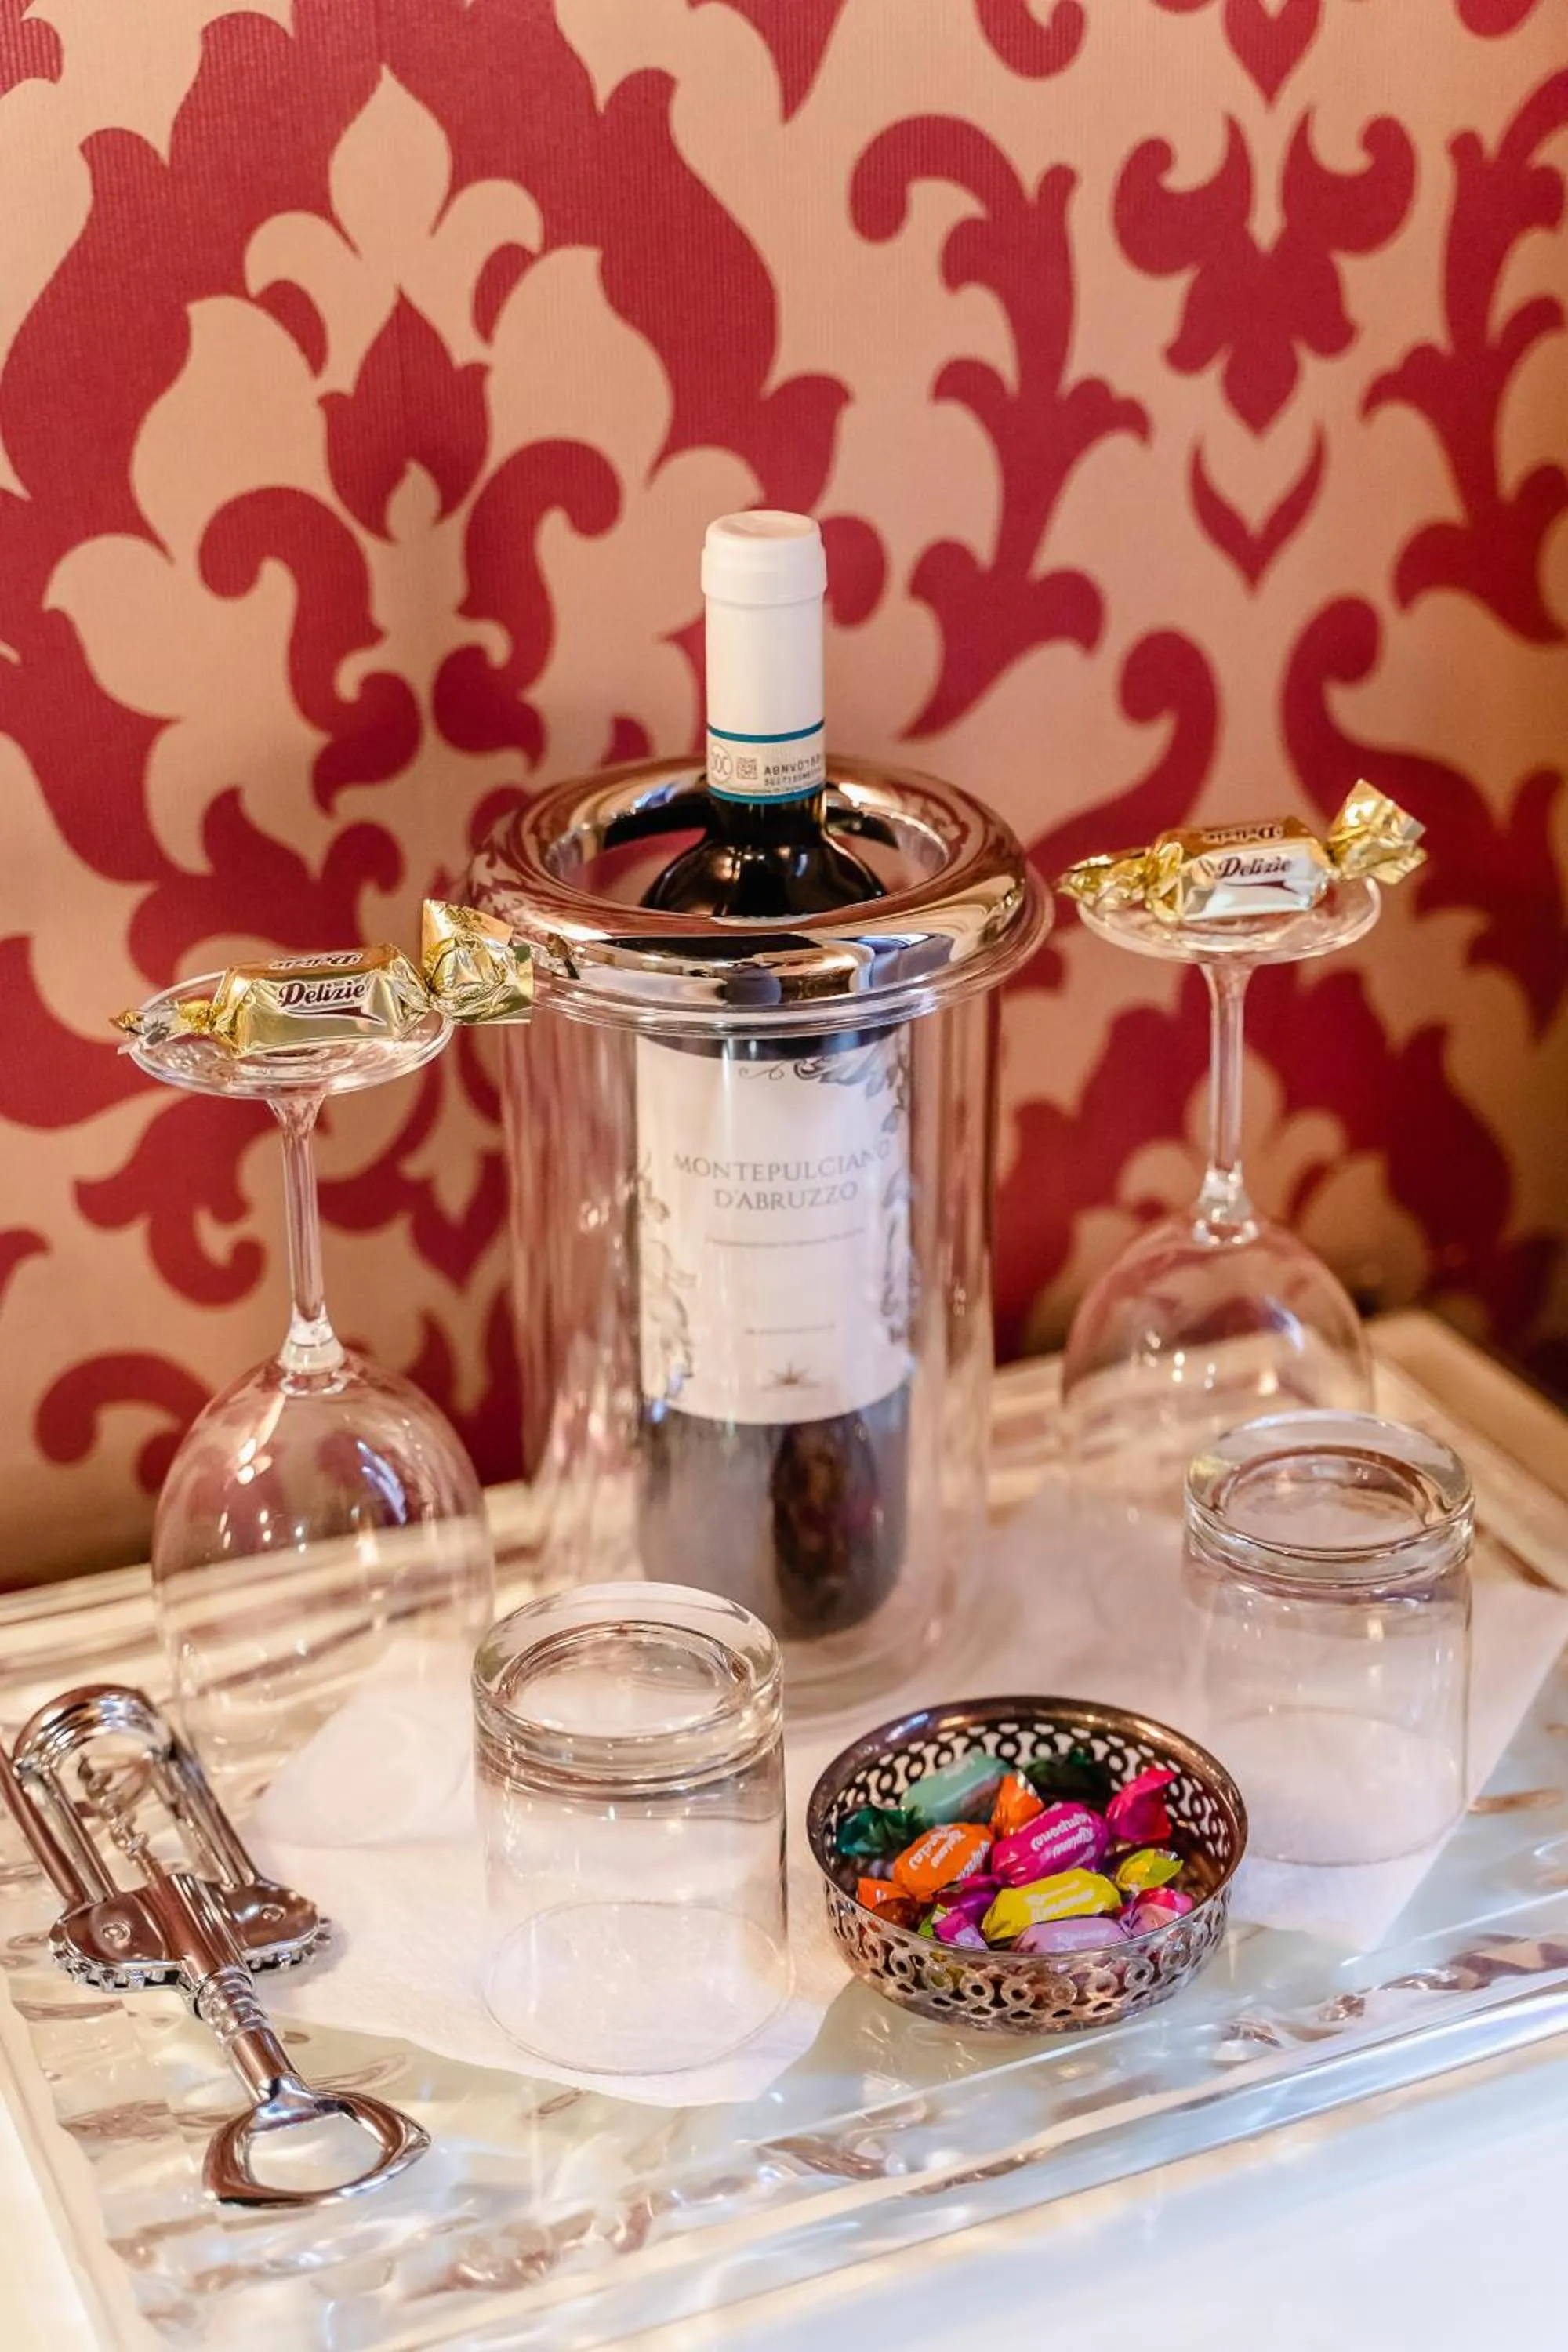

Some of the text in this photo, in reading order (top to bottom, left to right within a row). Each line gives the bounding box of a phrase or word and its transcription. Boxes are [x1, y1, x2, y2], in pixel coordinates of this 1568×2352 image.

[1218, 856, 1292, 879] Delizie
[278, 982, 366, 1007] Delizie
[673, 1139, 891, 1183] MONTEPULCIANO
[714, 1181, 858, 1211] D'ABRUZZO
